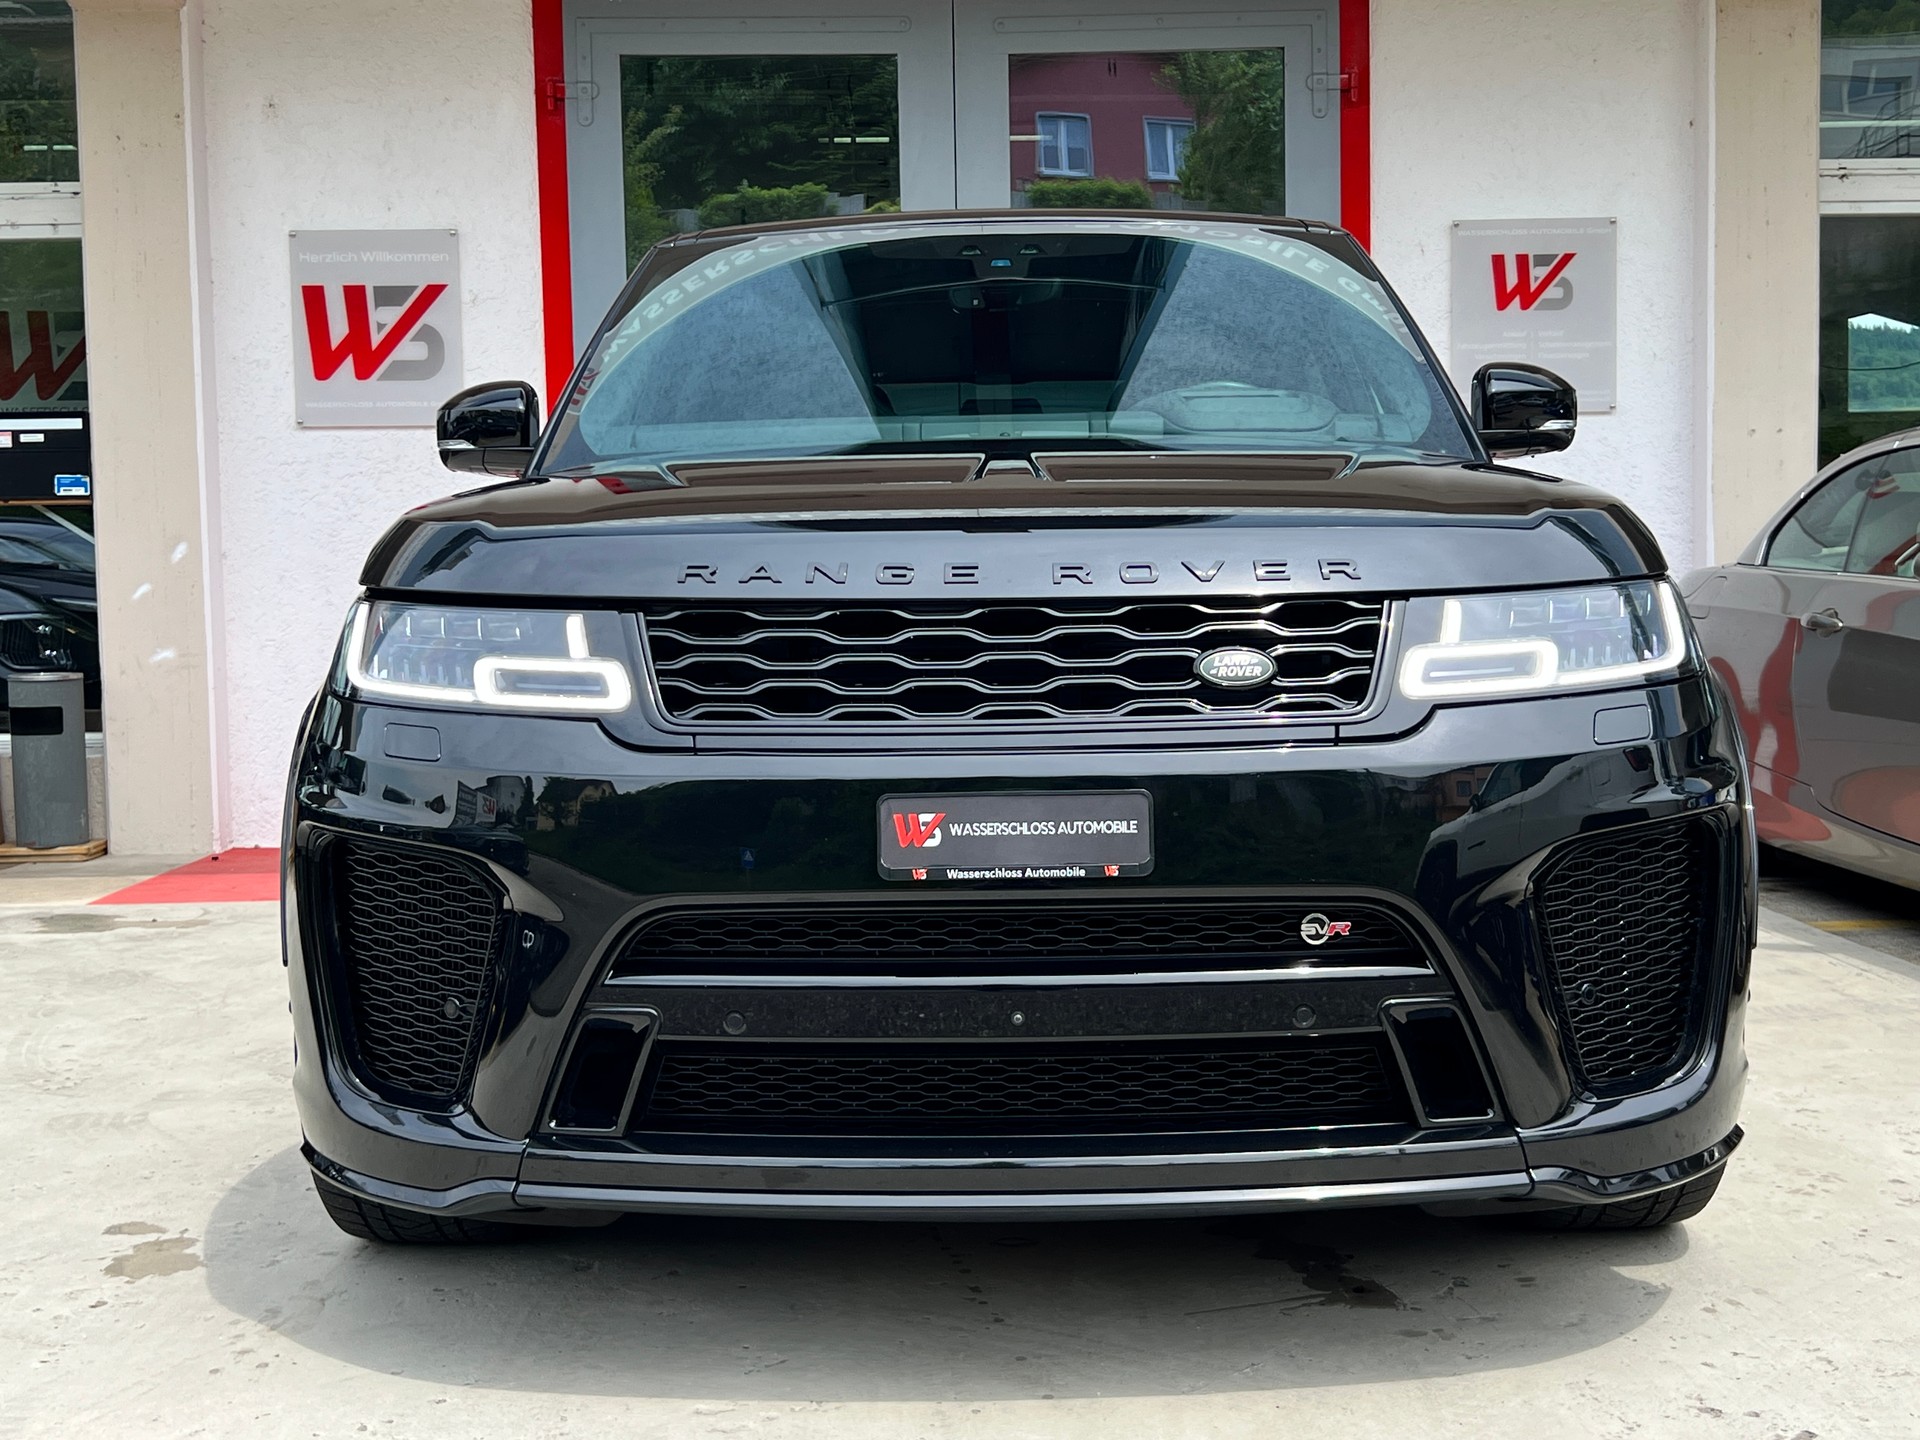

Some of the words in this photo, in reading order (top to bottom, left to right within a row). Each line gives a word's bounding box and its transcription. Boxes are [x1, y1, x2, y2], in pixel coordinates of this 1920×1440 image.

[299, 251, 357, 263] Herzlich
[360, 250, 449, 263] Willkommen
[677, 561, 979, 584] RANGE
[1052, 558, 1361, 584] ROVER
[1213, 654, 1250, 666] LAND
[1218, 666, 1263, 677] ROVER
[949, 821, 1056, 836] WASSERSCHLOSS
[1057, 820, 1138, 834] AUTOMOBILE
[947, 868, 1022, 879] Wasserschloss
[1024, 866, 1086, 878] Automobile
[1300, 916, 1352, 941] SVR
